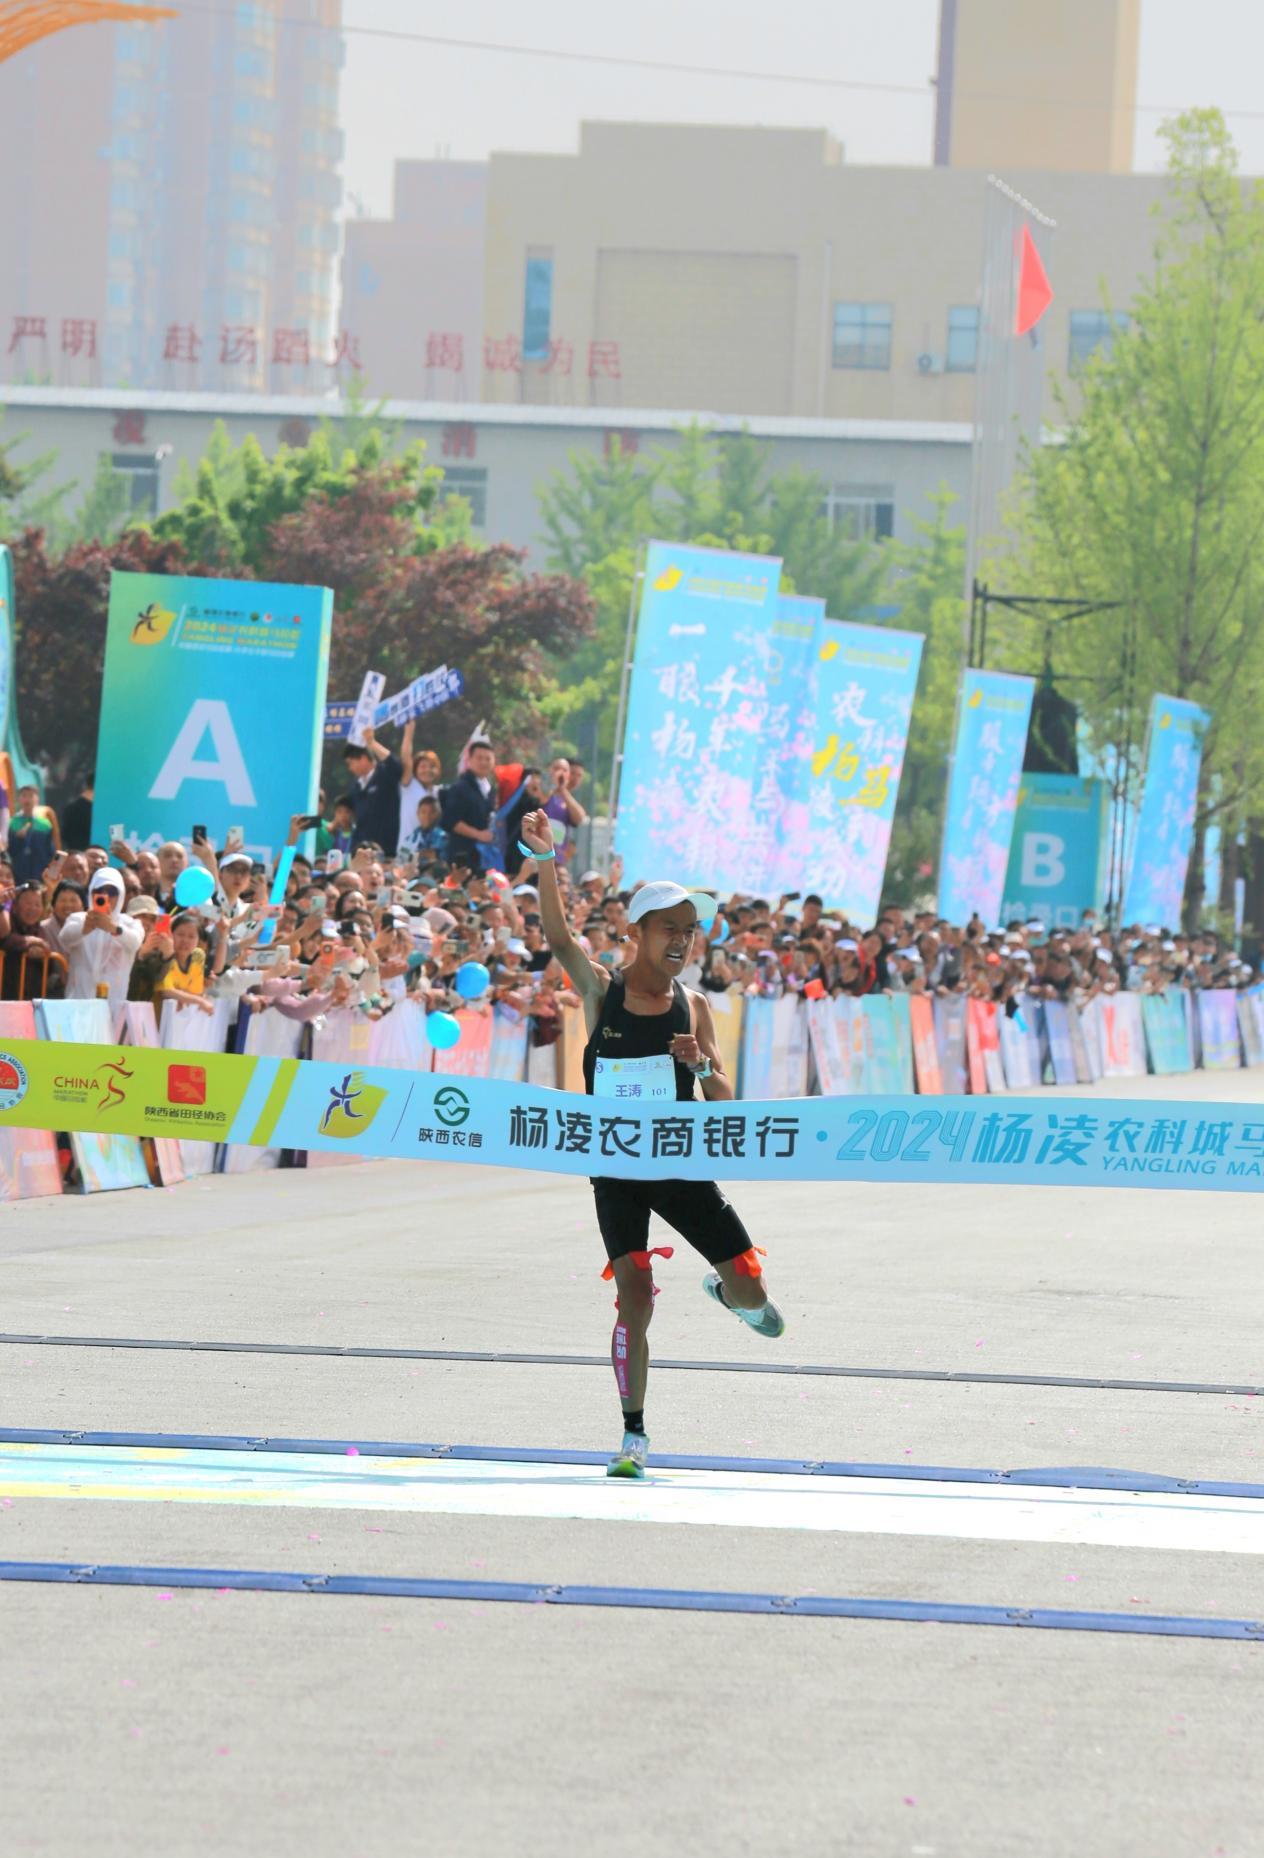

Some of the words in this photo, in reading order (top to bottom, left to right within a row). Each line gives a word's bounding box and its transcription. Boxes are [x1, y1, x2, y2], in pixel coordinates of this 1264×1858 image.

[7, 317, 97, 359] 严明
[163, 321, 363, 369] 赴汤蹈火
[424, 331, 623, 380] 竭诚为民
[147, 698, 258, 808] A
[1020, 832, 1065, 887] B
[53, 1076, 100, 1090] CHINA
[615, 1084, 642, 1098] 王涛
[652, 1087, 667, 1096] 101
[144, 1105, 226, 1122] 陕西省田径协会
[418, 1127, 483, 1149] 陕西农信
[508, 1105, 800, 1159] 杨凌农商银行
[1102, 1156, 1217, 1175] YANGLING
[1226, 1161, 1264, 1177] MA
